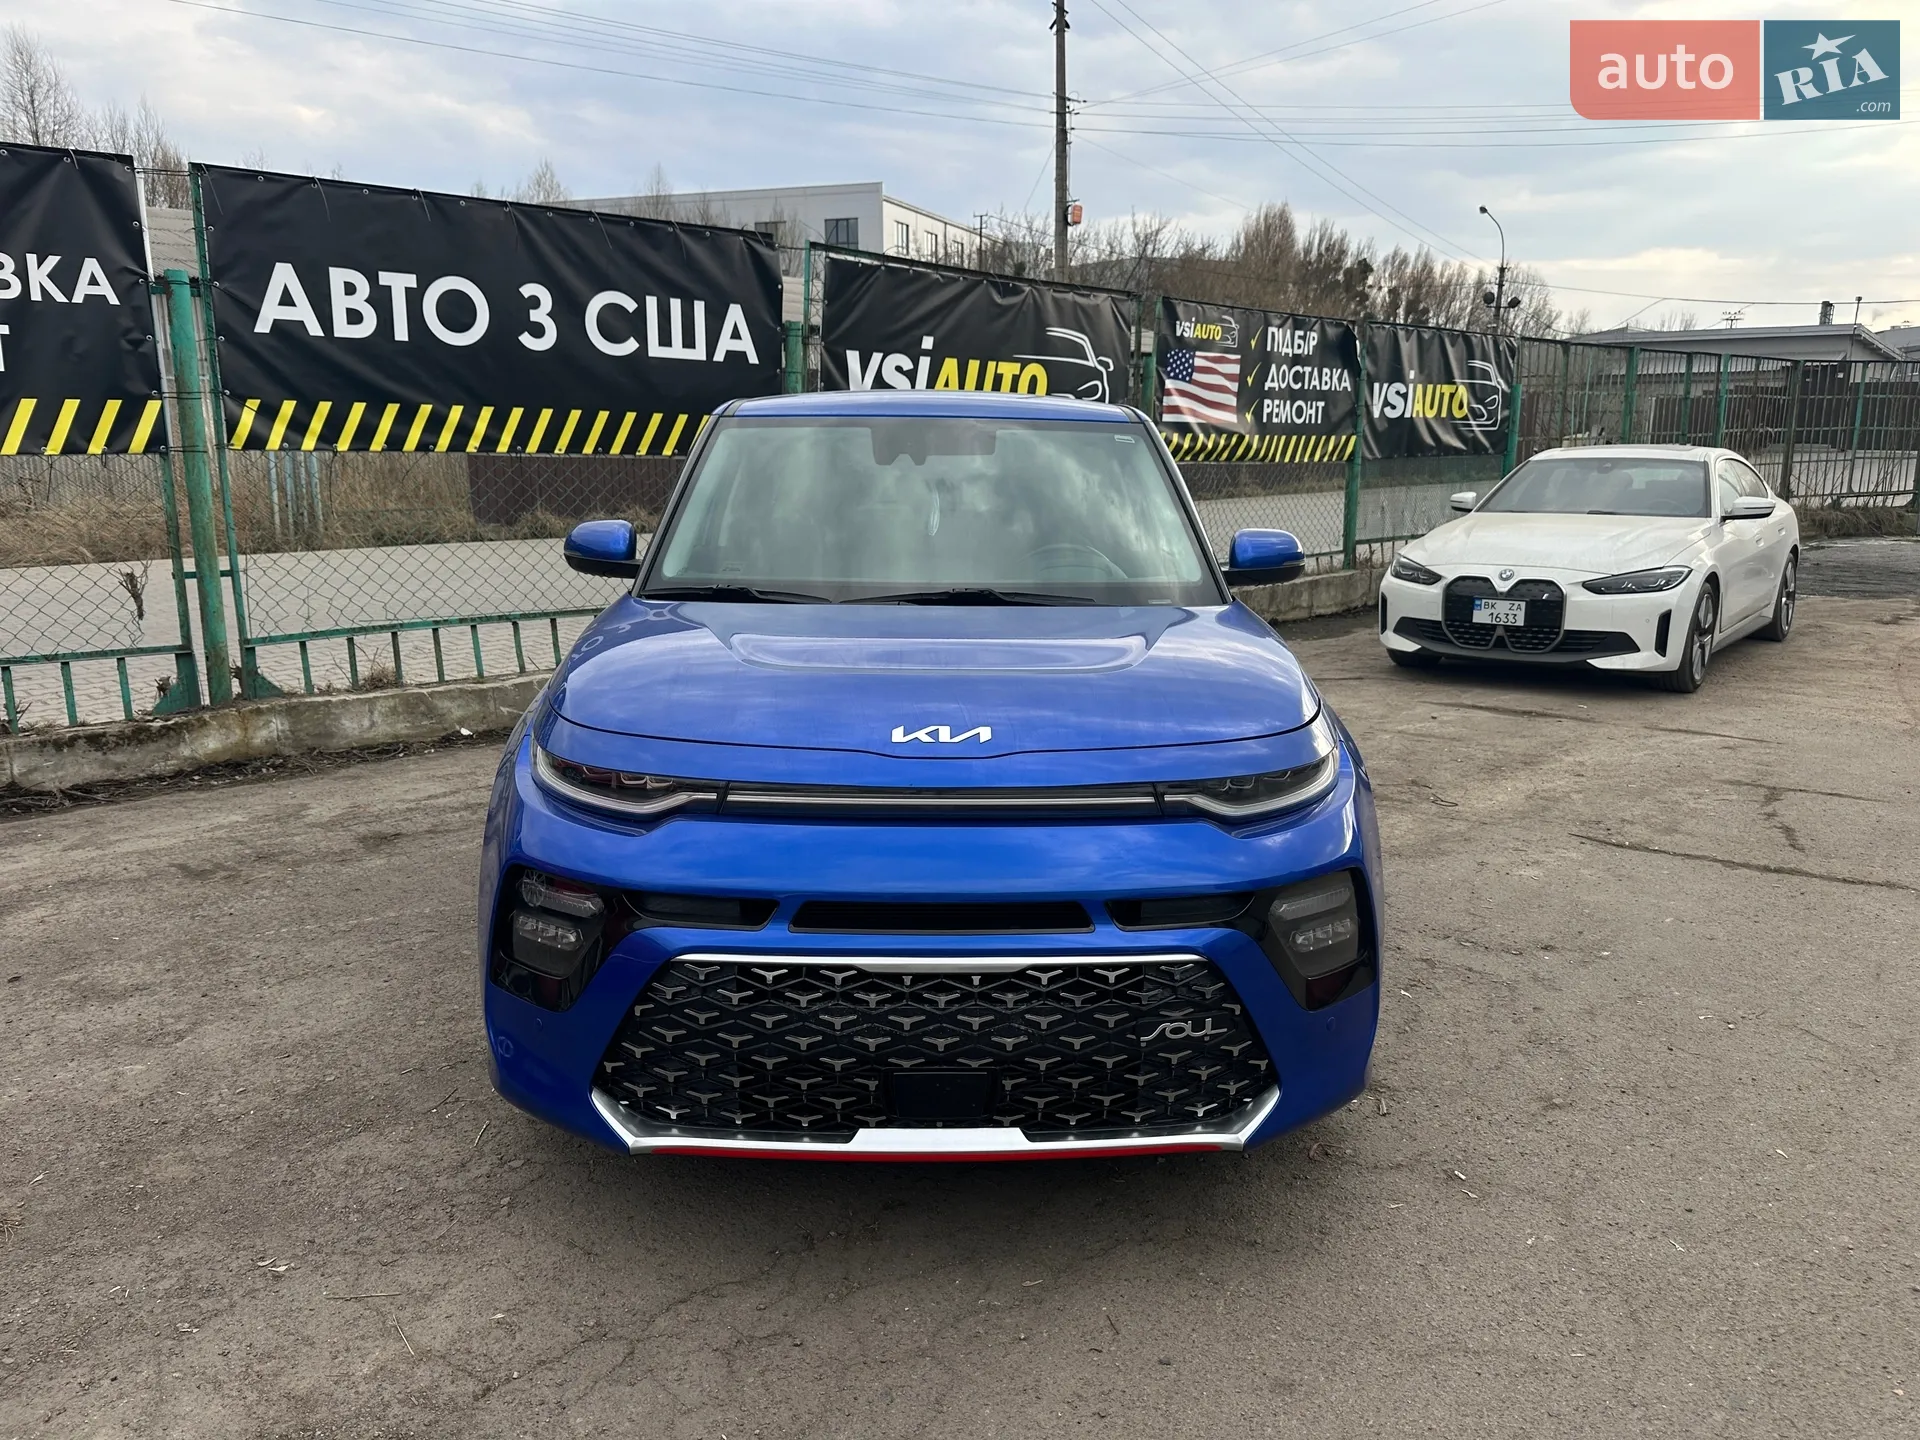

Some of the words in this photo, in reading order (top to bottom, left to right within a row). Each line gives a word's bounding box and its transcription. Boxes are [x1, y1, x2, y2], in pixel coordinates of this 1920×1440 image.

[253, 262, 490, 348] АВТО
[584, 291, 760, 365] США
[1266, 326, 1318, 357] ПІДБІР
[1264, 363, 1352, 392] ДОСТАВКА
[1262, 399, 1325, 424] РЕМОНТ
[1483, 601, 1497, 610] BK
[1508, 602, 1522, 611] ZA
[1488, 612, 1518, 624] 1633
